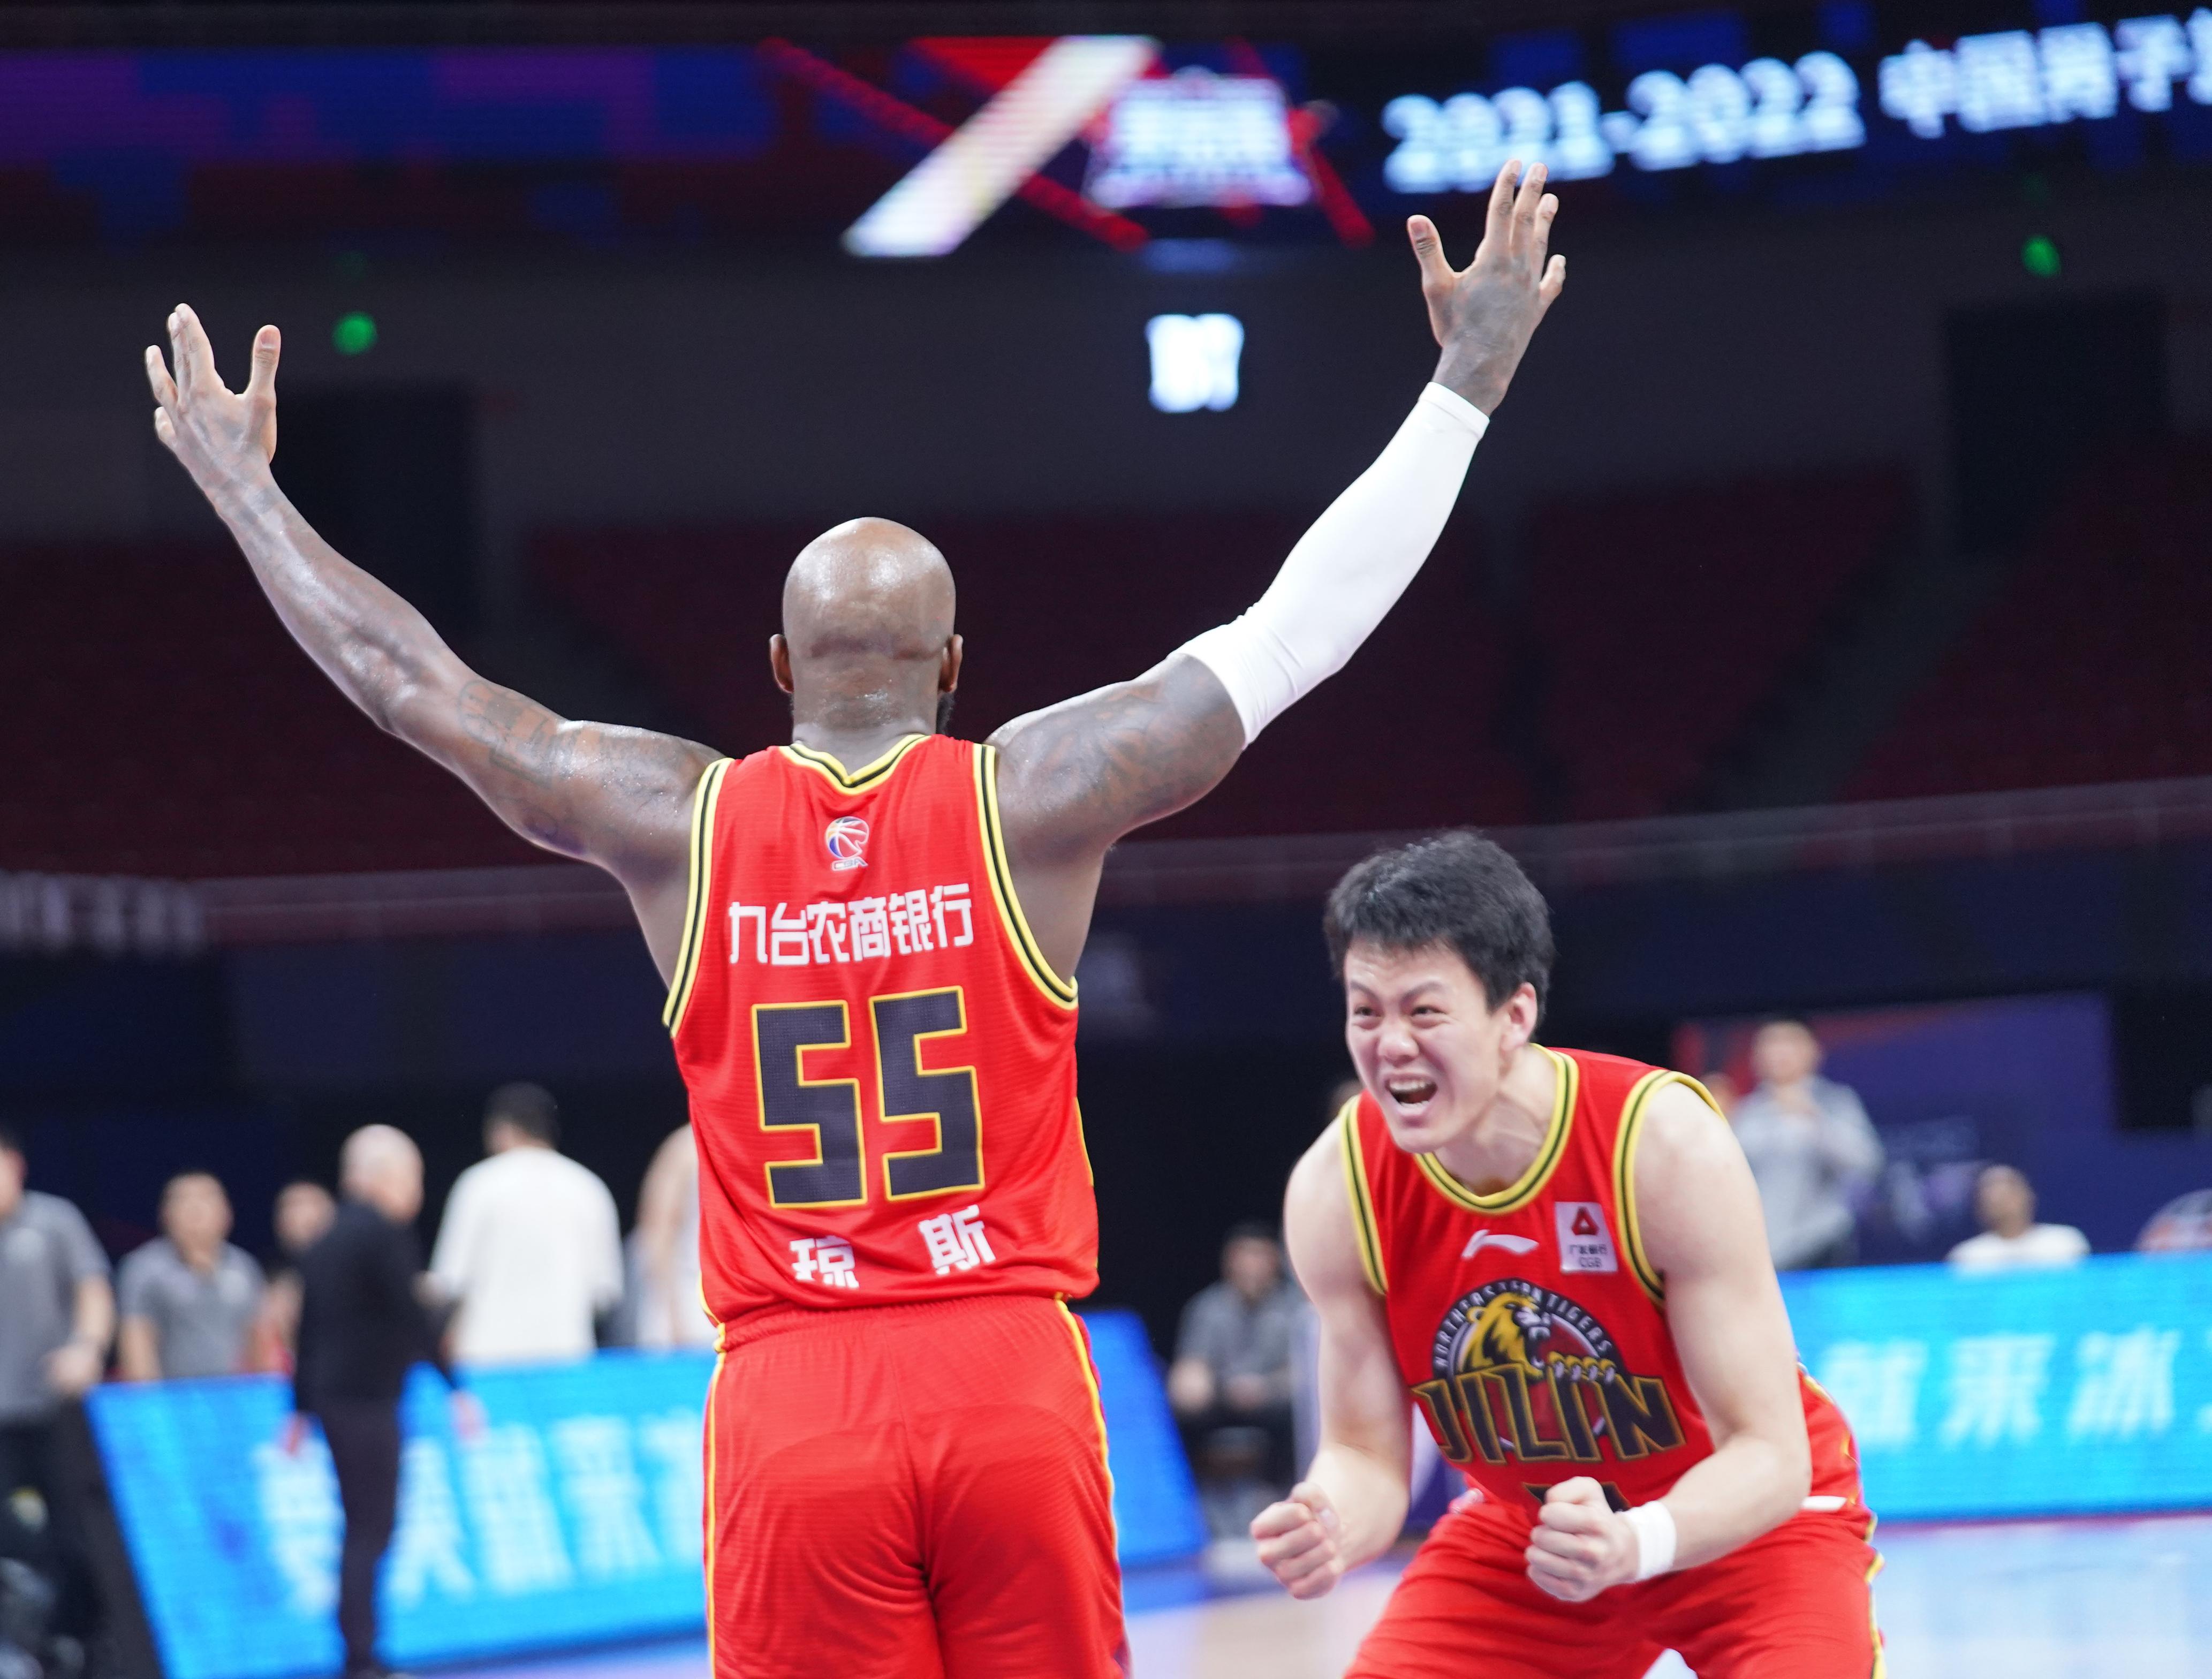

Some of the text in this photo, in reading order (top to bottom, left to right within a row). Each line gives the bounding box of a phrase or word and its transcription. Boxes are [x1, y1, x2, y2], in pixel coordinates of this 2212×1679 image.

[1382, 49, 1867, 195] 2021-2022
[728, 882, 974, 966] 九台农商银行
[751, 985, 985, 1209] 55
[1546, 1292, 1613, 1358] TIGERS
[1411, 1362, 1687, 1465] JILIN
